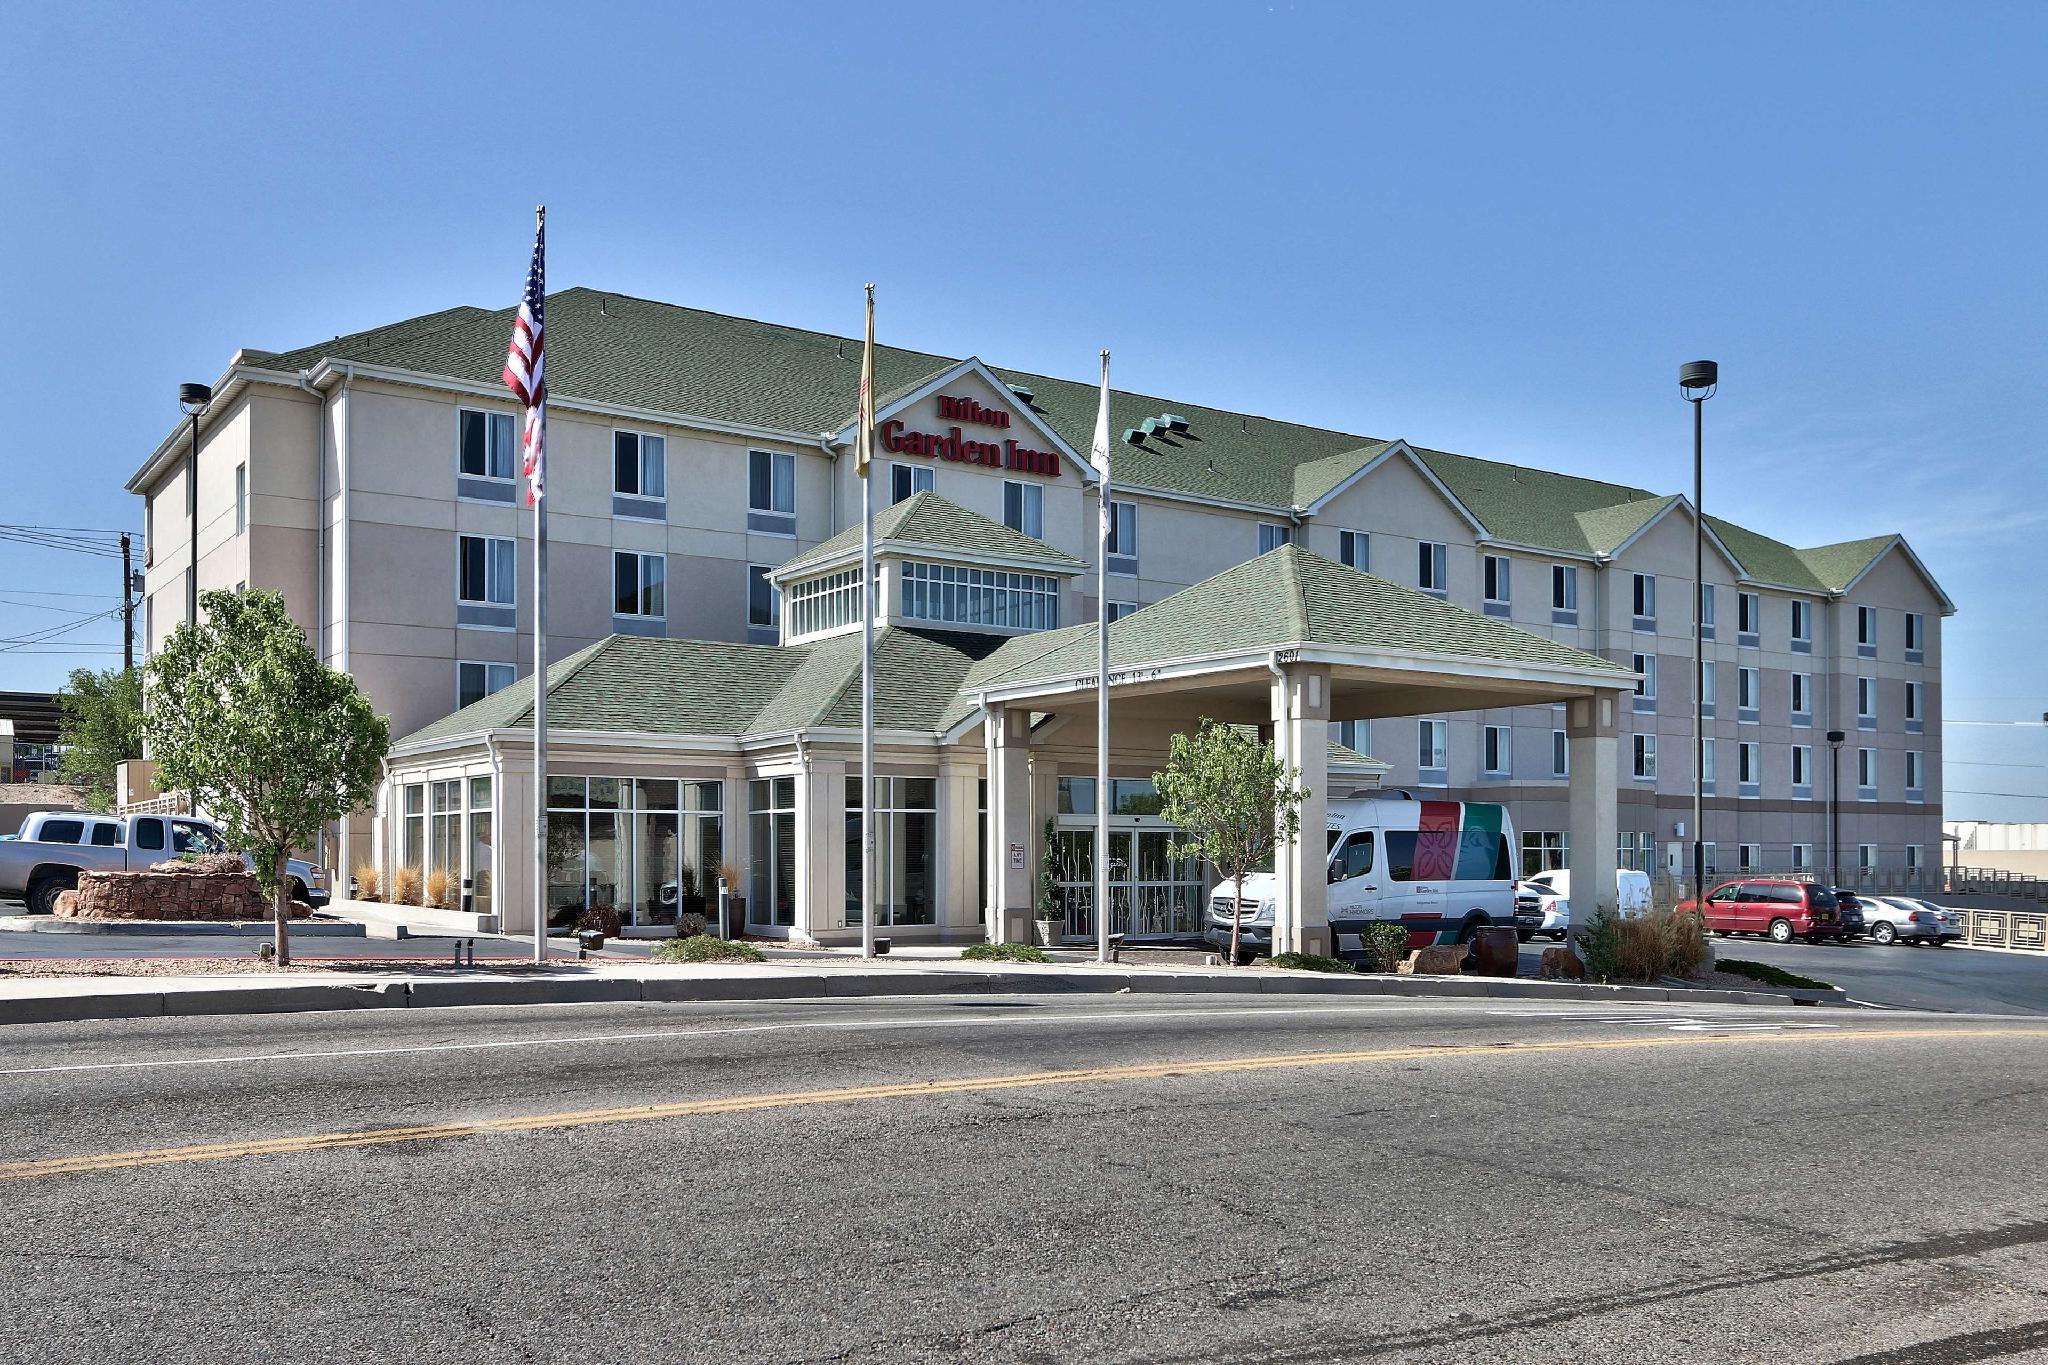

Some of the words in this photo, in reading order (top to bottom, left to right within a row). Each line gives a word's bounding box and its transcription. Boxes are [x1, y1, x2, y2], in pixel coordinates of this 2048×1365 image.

[938, 394, 1011, 429] Hilton
[881, 419, 1004, 468] Garden
[1004, 438, 1062, 477] Inn
[1076, 672, 1126, 690] CLEANCE
